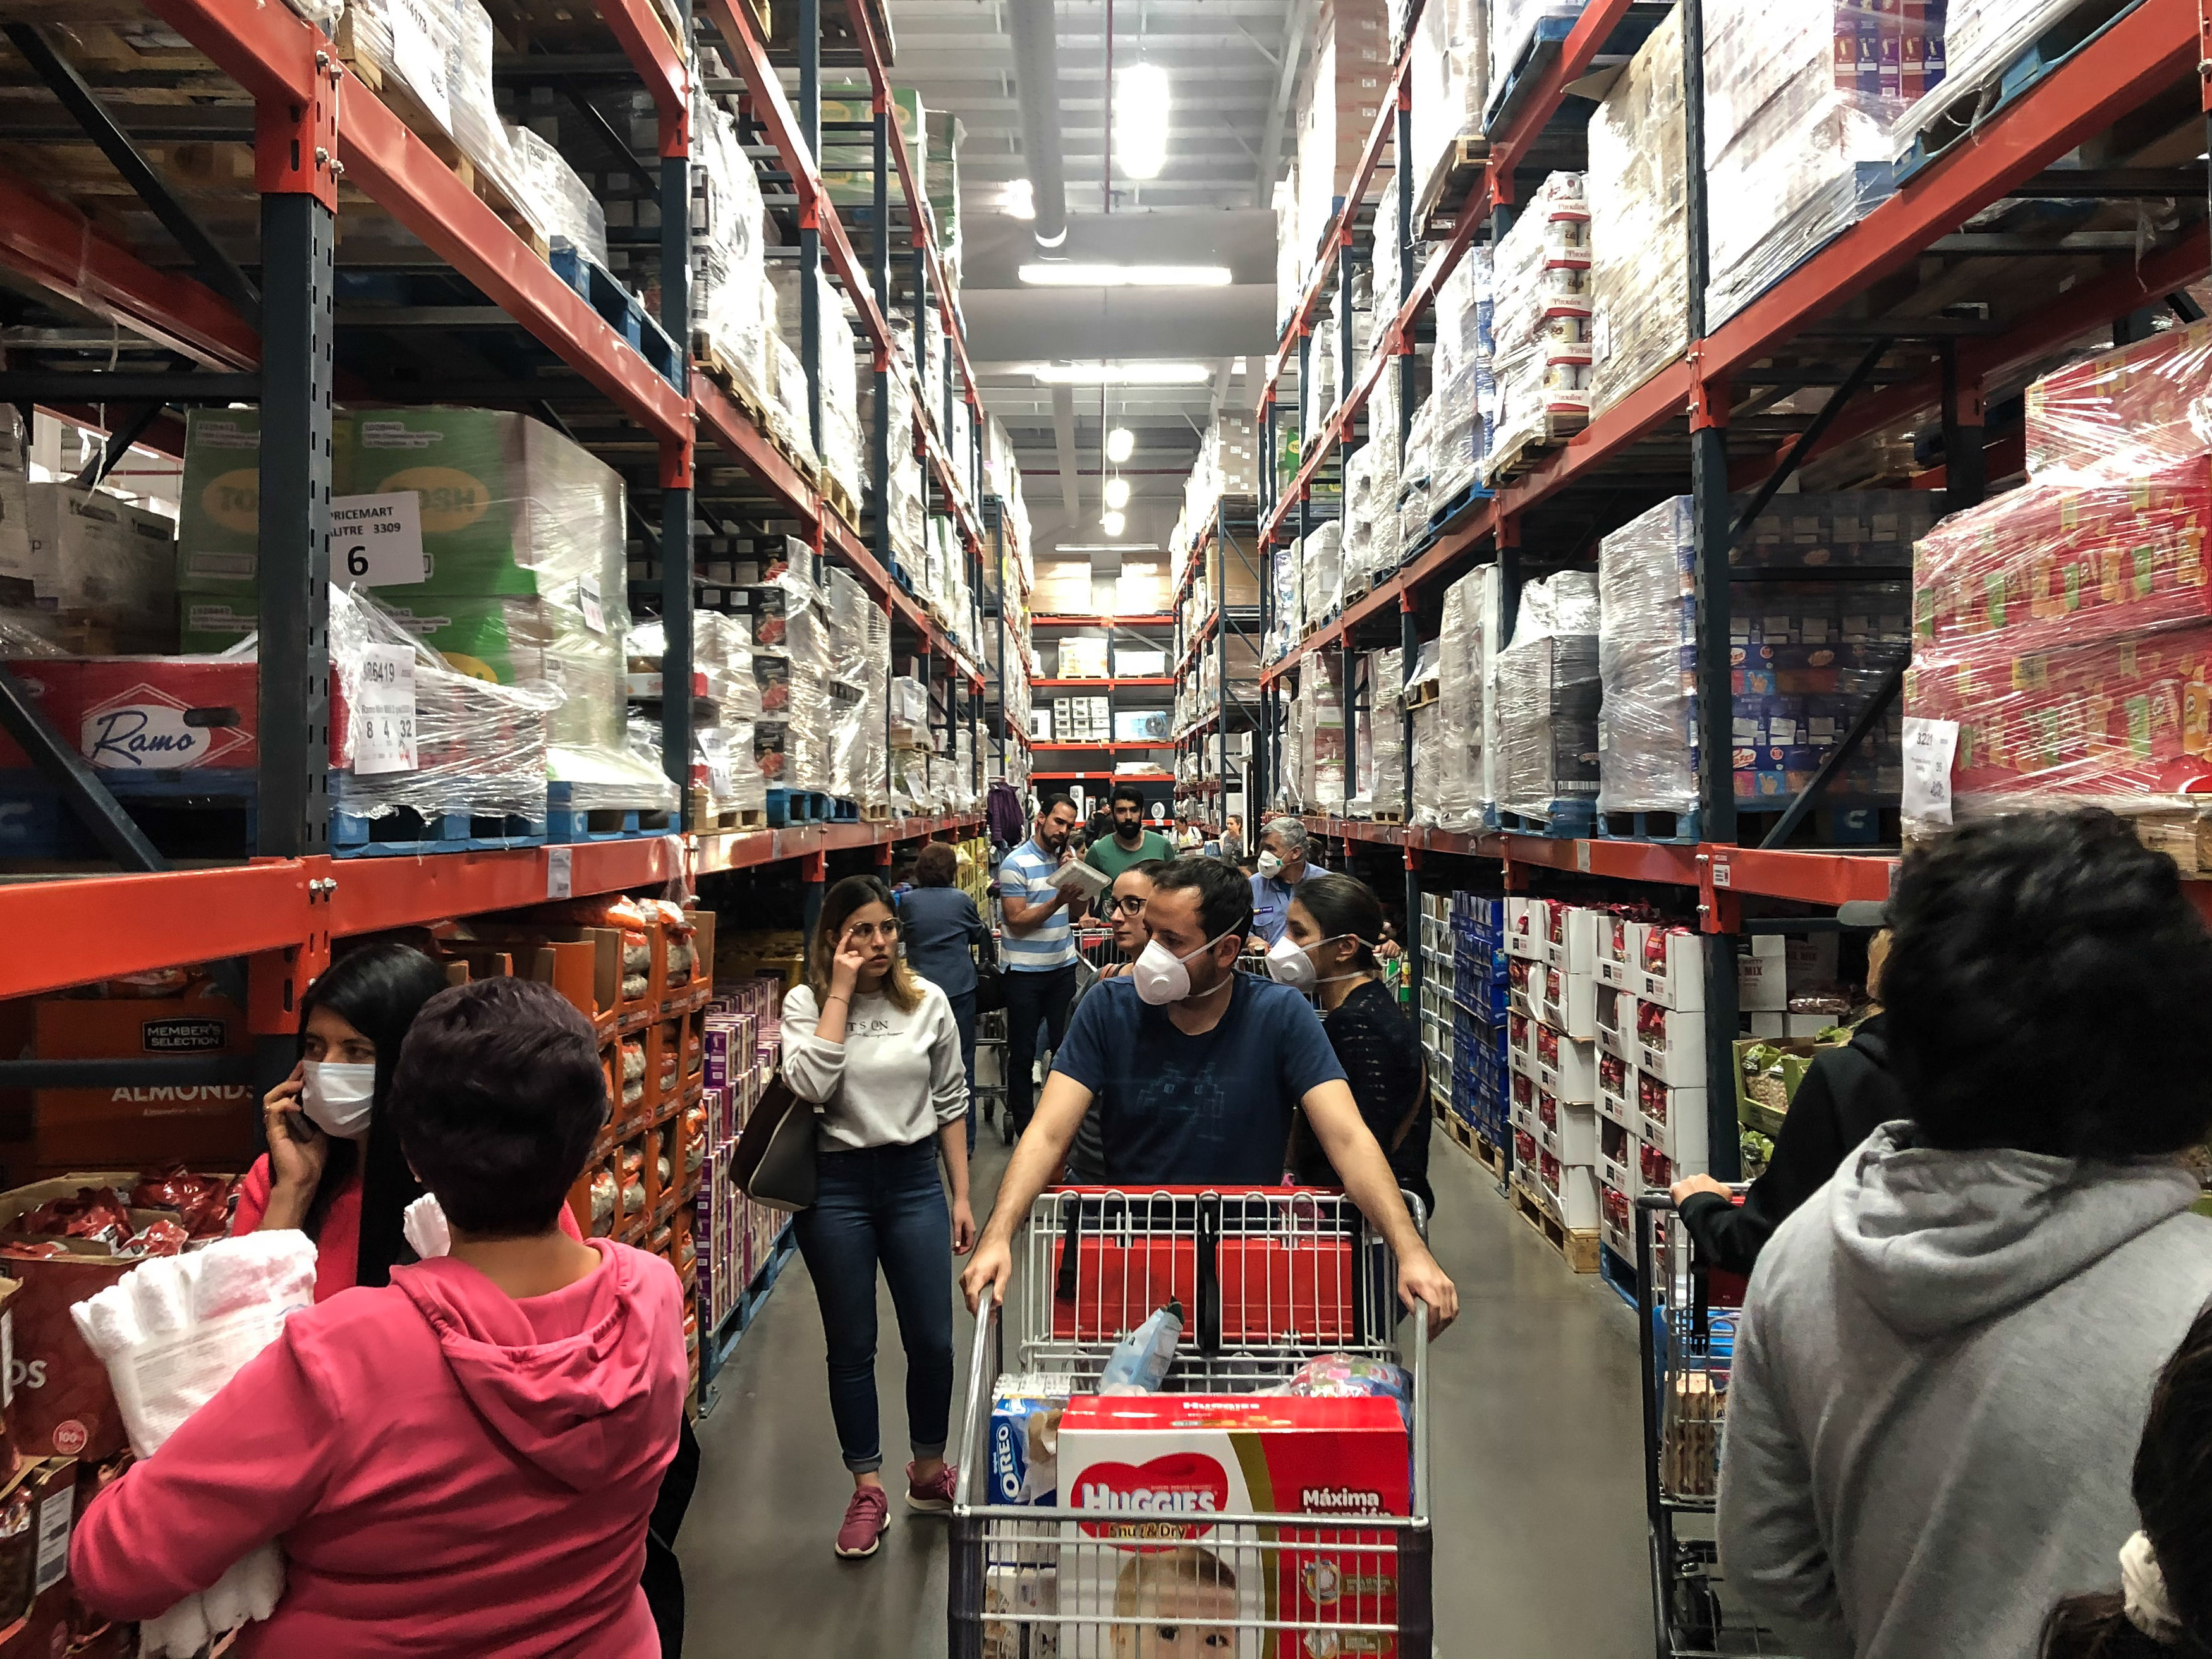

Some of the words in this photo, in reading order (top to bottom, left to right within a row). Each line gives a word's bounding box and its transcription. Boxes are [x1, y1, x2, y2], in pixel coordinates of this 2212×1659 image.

[331, 506, 394, 521] RICEMART
[331, 525, 363, 537] LITRE
[373, 522, 401, 533] 3309
[348, 545, 368, 576] 6
[367, 720, 374, 739] 8
[384, 720, 390, 739] 4
[400, 719, 412, 738] 32
[91, 710, 195, 765] Ramo
[1744, 966, 1763, 976] MIX
[147, 1024, 221, 1036] MEMBER'S
[151, 1037, 219, 1047] SELECTION
[998, 1425, 1020, 1498] OREO
[1303, 1488, 1380, 1507] Máxima
[1160, 1523, 1187, 1539] Dry
